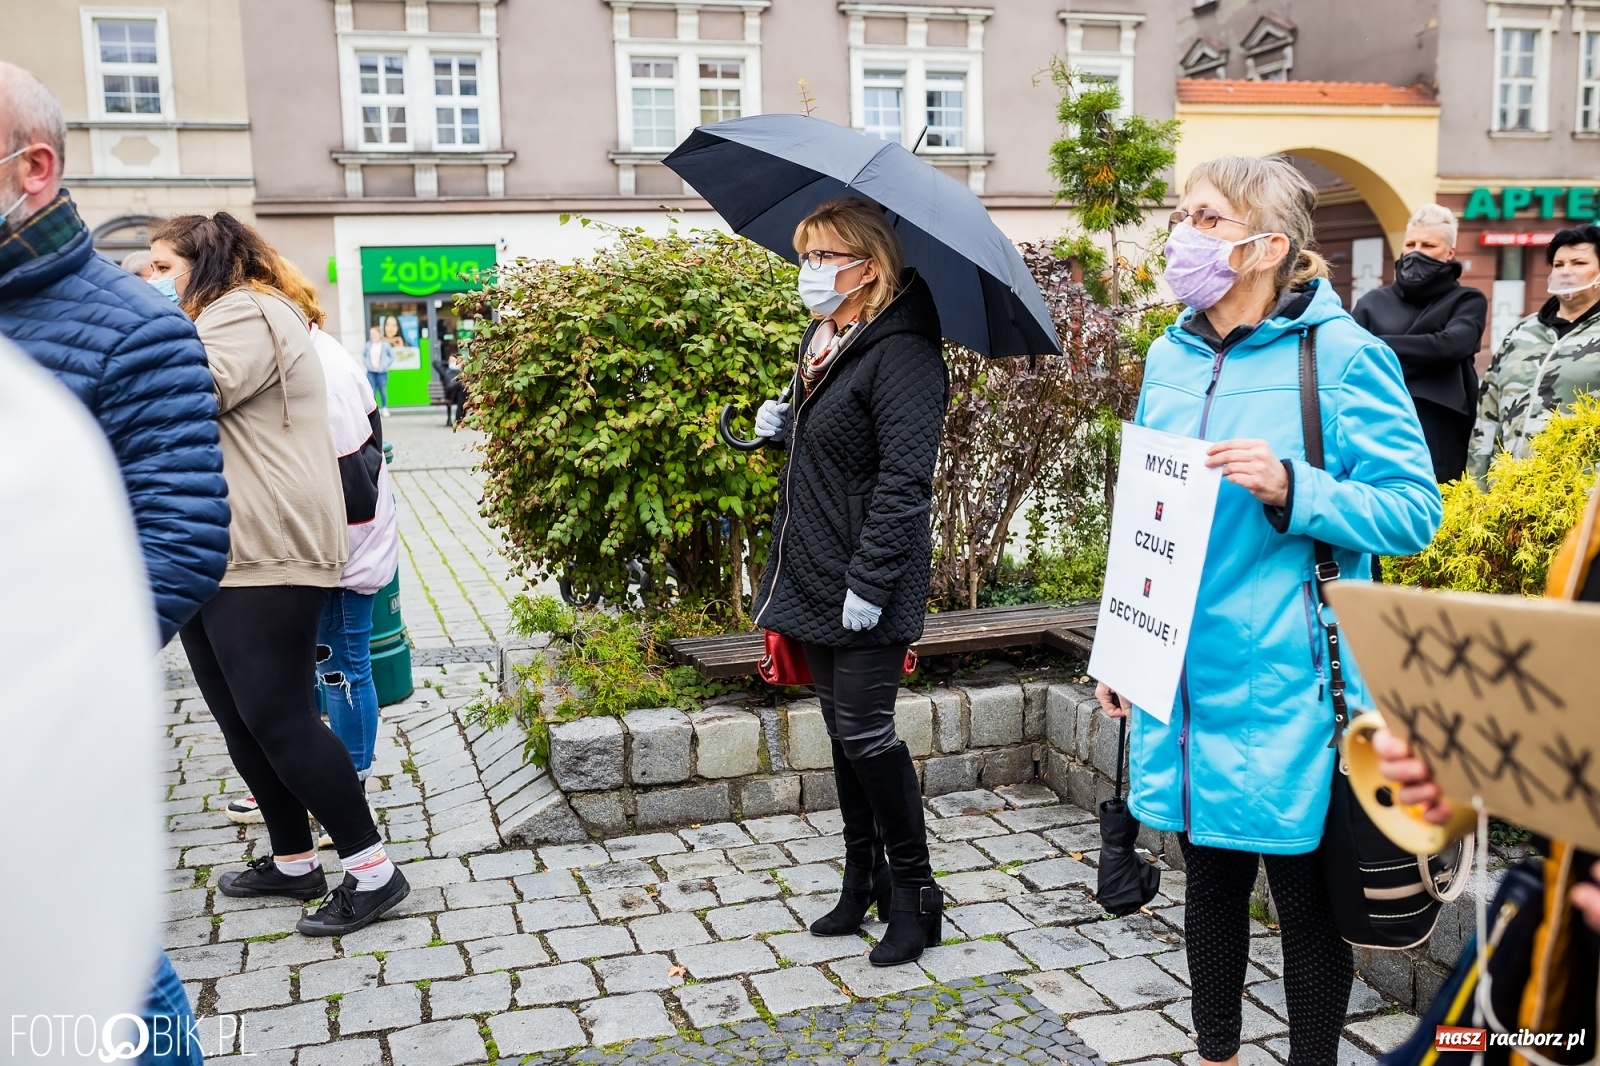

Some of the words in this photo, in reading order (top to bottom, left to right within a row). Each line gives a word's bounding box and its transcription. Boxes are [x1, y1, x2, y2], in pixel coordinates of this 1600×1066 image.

[1463, 186, 1600, 220] APTE
[380, 255, 479, 283] żabka
[1145, 454, 1189, 486] MYŚLĘ
[1135, 530, 1175, 564] CZUJĘ
[1109, 597, 1170, 646] DECYDUJĘ
